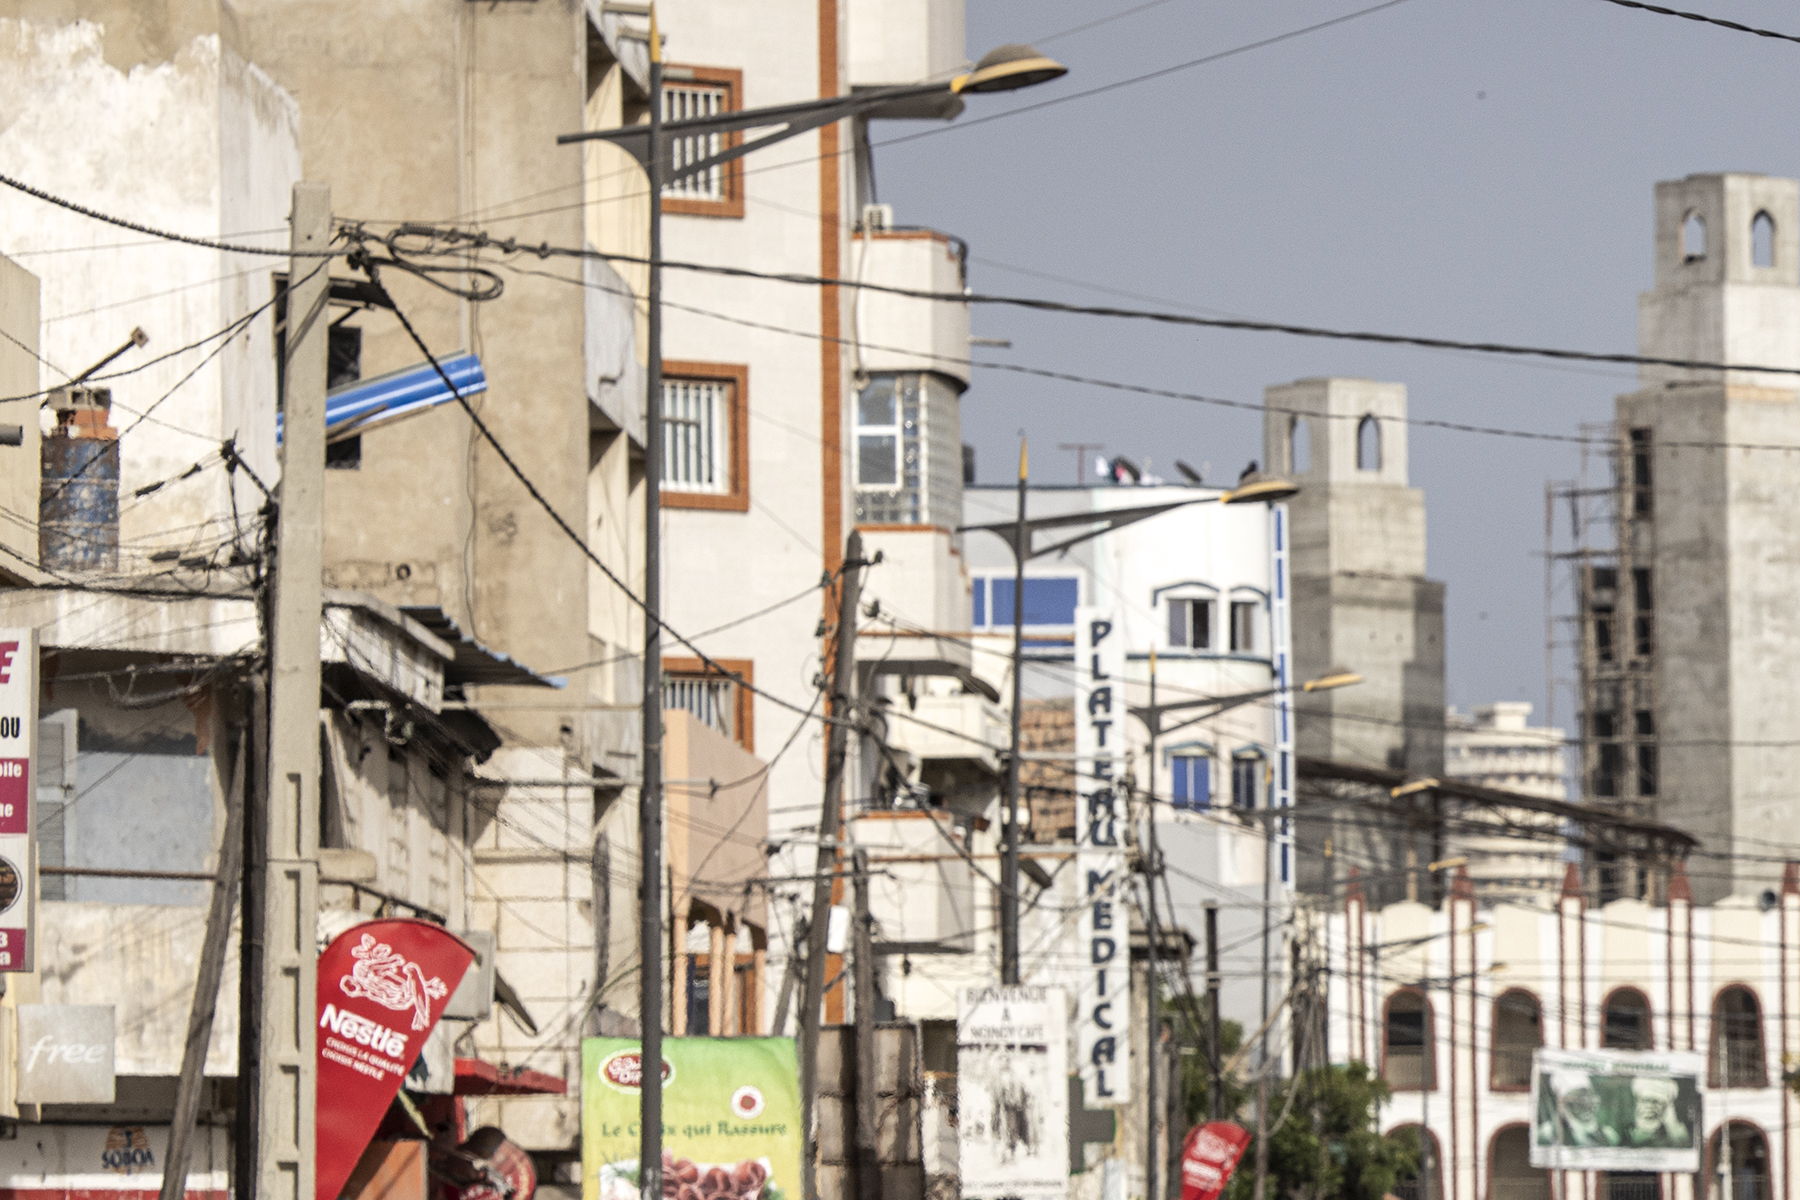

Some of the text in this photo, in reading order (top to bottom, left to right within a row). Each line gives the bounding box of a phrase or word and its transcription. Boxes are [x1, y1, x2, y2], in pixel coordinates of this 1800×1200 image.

[1088, 620, 1118, 847] PLATEAU
[1087, 869, 1117, 1098] MEDICAL
[26, 1034, 107, 1073] free
[320, 1003, 409, 1058] Nestlé
[602, 1121, 621, 1138] Le
[683, 1121, 711, 1140] qui
[718, 1120, 786, 1138] Rassure
